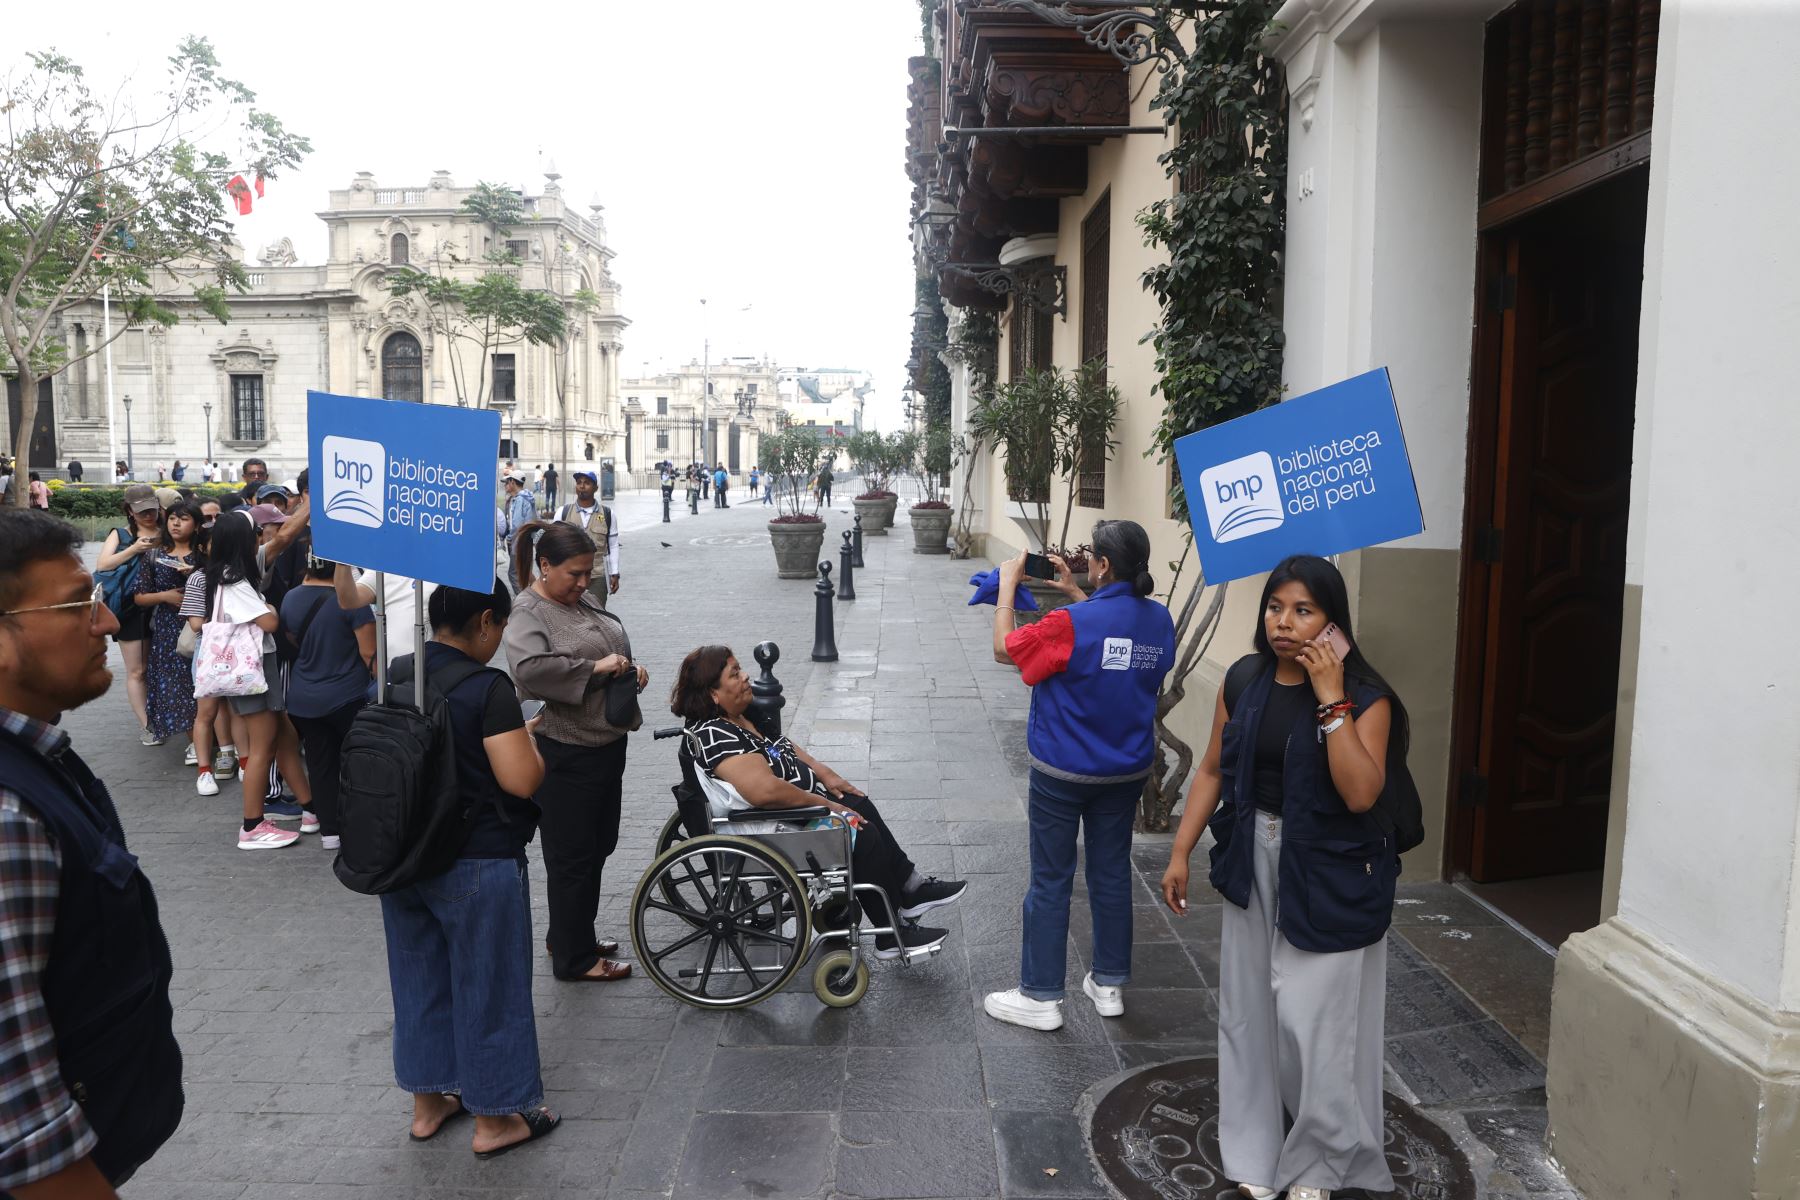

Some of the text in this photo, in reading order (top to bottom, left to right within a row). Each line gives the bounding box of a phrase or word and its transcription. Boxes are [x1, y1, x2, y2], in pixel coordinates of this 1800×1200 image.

[1277, 430, 1381, 475] biblioteca
[334, 451, 373, 489] bnp
[389, 455, 478, 490] biblioteca
[1282, 451, 1372, 495] nacional
[388, 484, 465, 512] nacional
[1215, 474, 1263, 503] bnp
[1287, 473, 1376, 515] del perú
[388, 503, 463, 535] del perú
[1110, 644, 1127, 657] bnp
[1131, 660, 1140, 668] del
[1132, 652, 1158, 661] nacional
[1133, 644, 1163, 654] biblioteca
